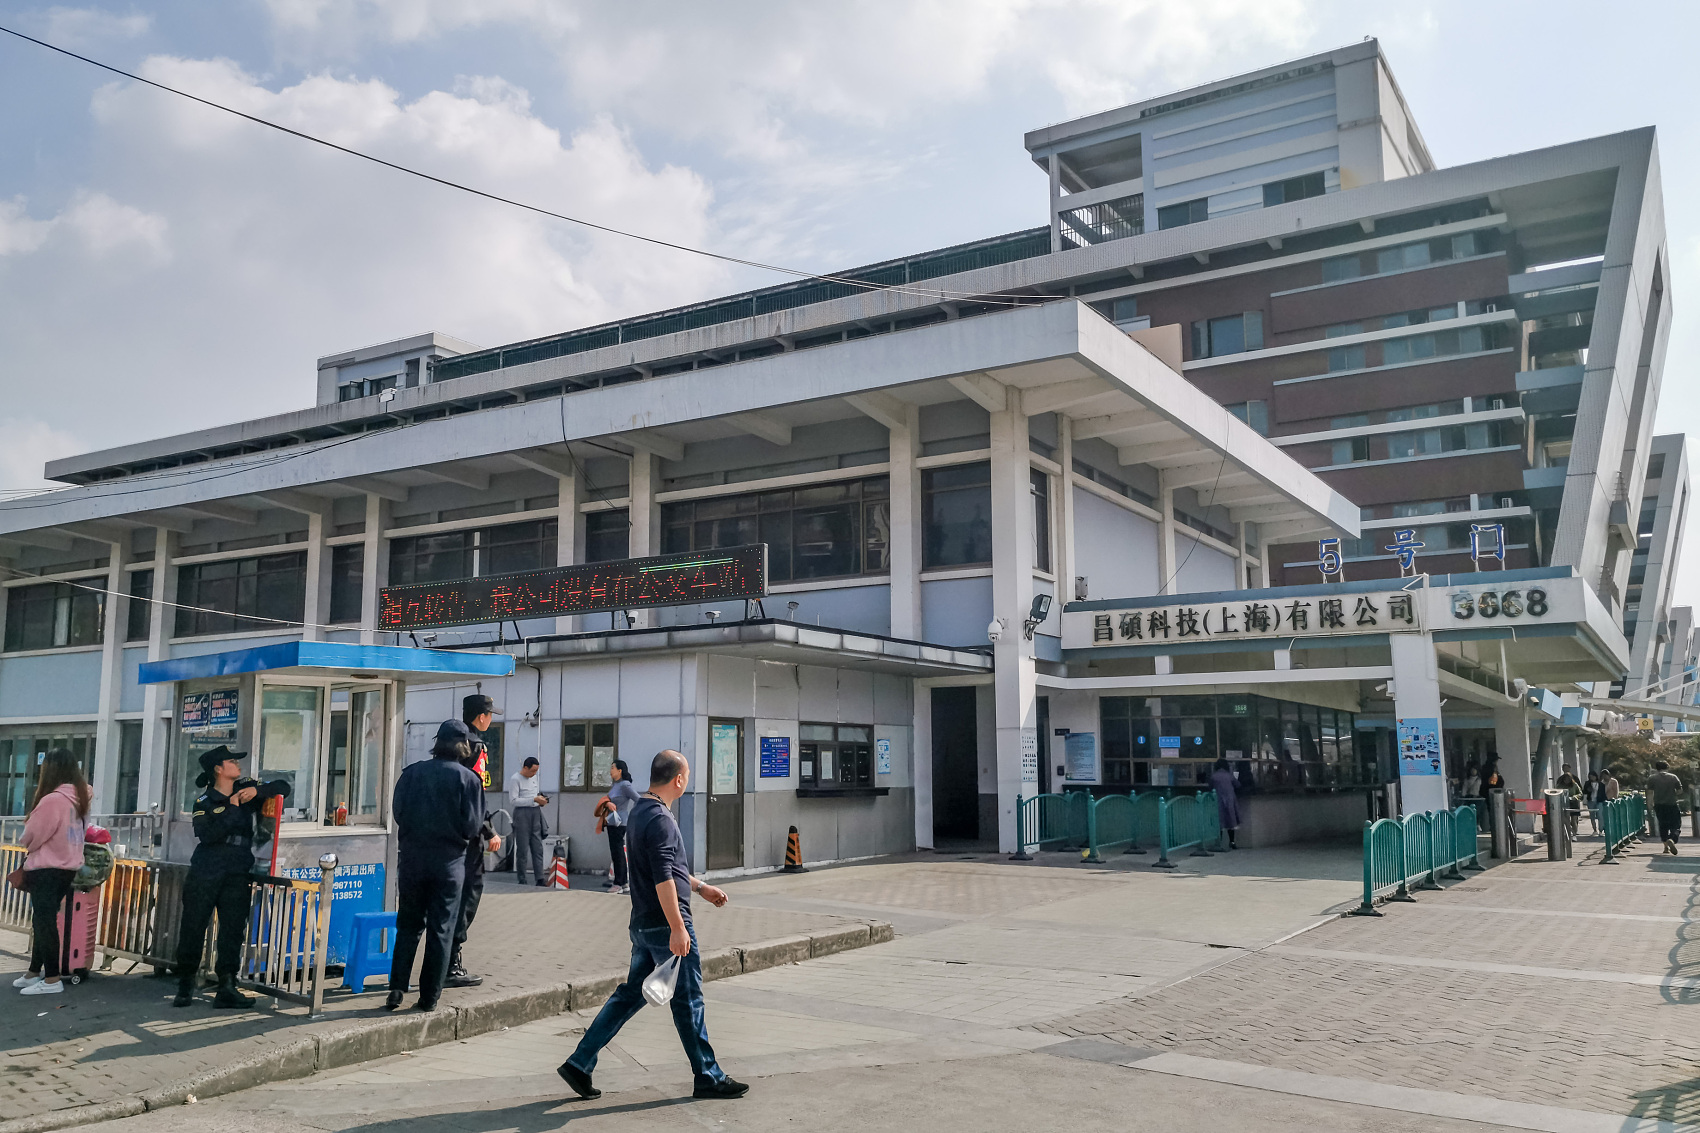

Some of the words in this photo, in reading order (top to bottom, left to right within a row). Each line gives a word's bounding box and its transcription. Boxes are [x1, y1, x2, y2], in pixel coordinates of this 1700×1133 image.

[1318, 523, 1505, 575] 5号门
[282, 864, 376, 879] 浦东公安分横沔派出所
[332, 880, 363, 890] 987110
